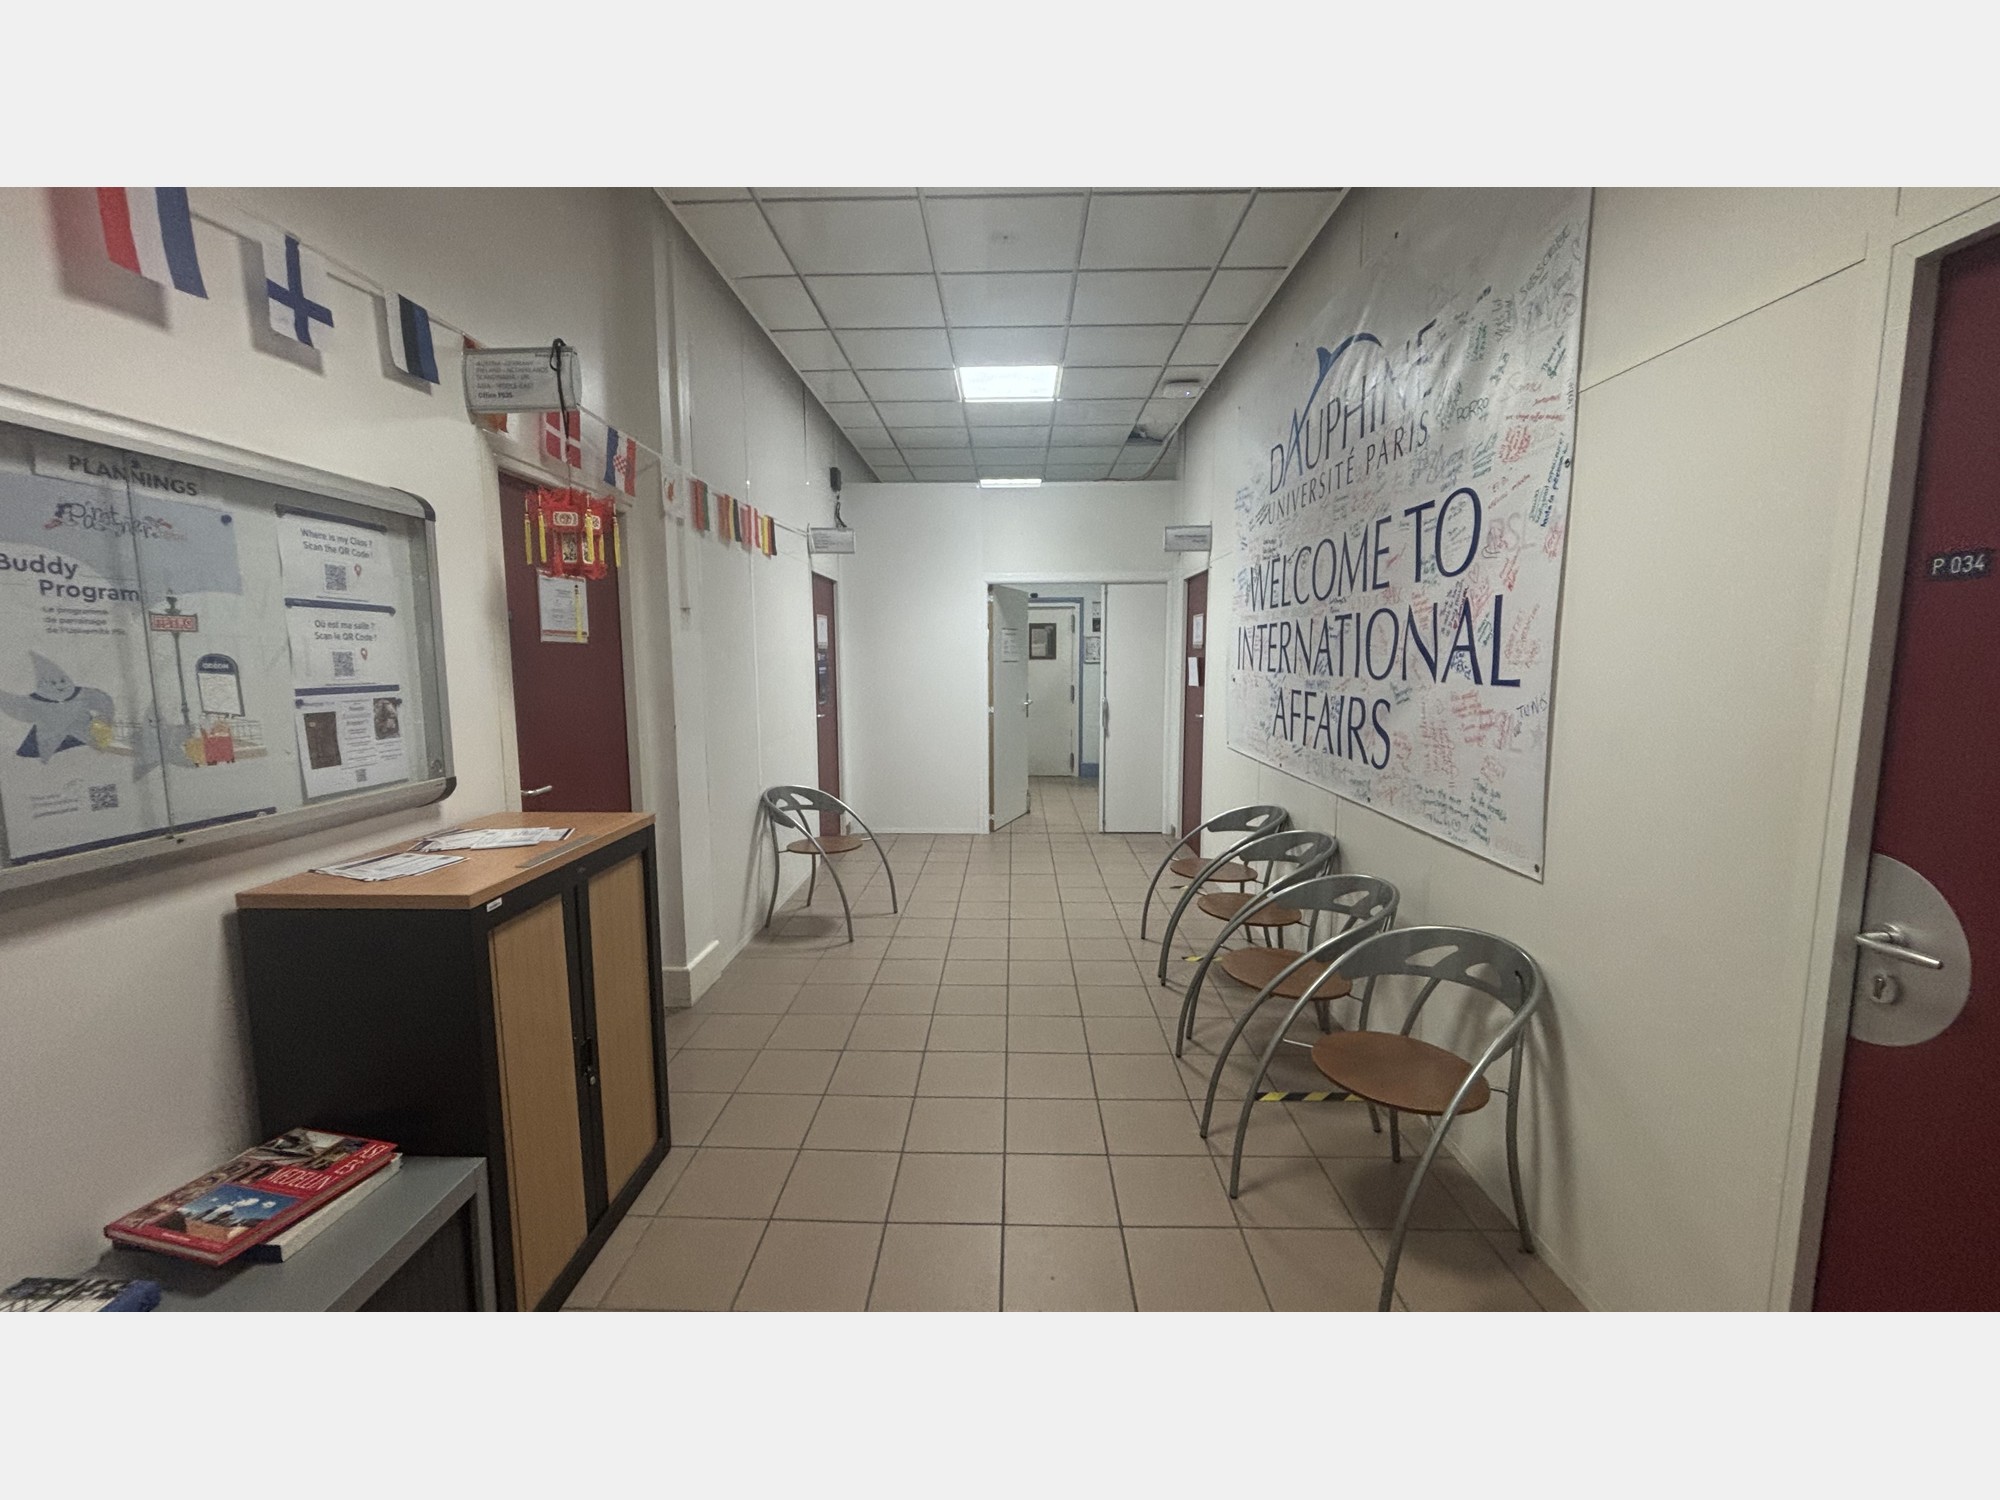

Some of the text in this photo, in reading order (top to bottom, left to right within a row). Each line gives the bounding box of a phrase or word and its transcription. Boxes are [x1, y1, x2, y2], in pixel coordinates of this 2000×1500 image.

[69, 454, 199, 497] PLANNINGS
[1266, 447, 1356, 525] UNIVERSITÉ
[1365, 409, 1429, 476] PARIS
[0, 553, 78, 580] Buddy
[1250, 515, 1391, 612] WELCOME
[1404, 487, 1483, 583] TO
[1932, 553, 1986, 575] P 034
[39, 579, 140, 603] Program
[1237, 593, 1521, 688] INTERNATIONAL
[1273, 687, 1392, 770] AFFAIRS
